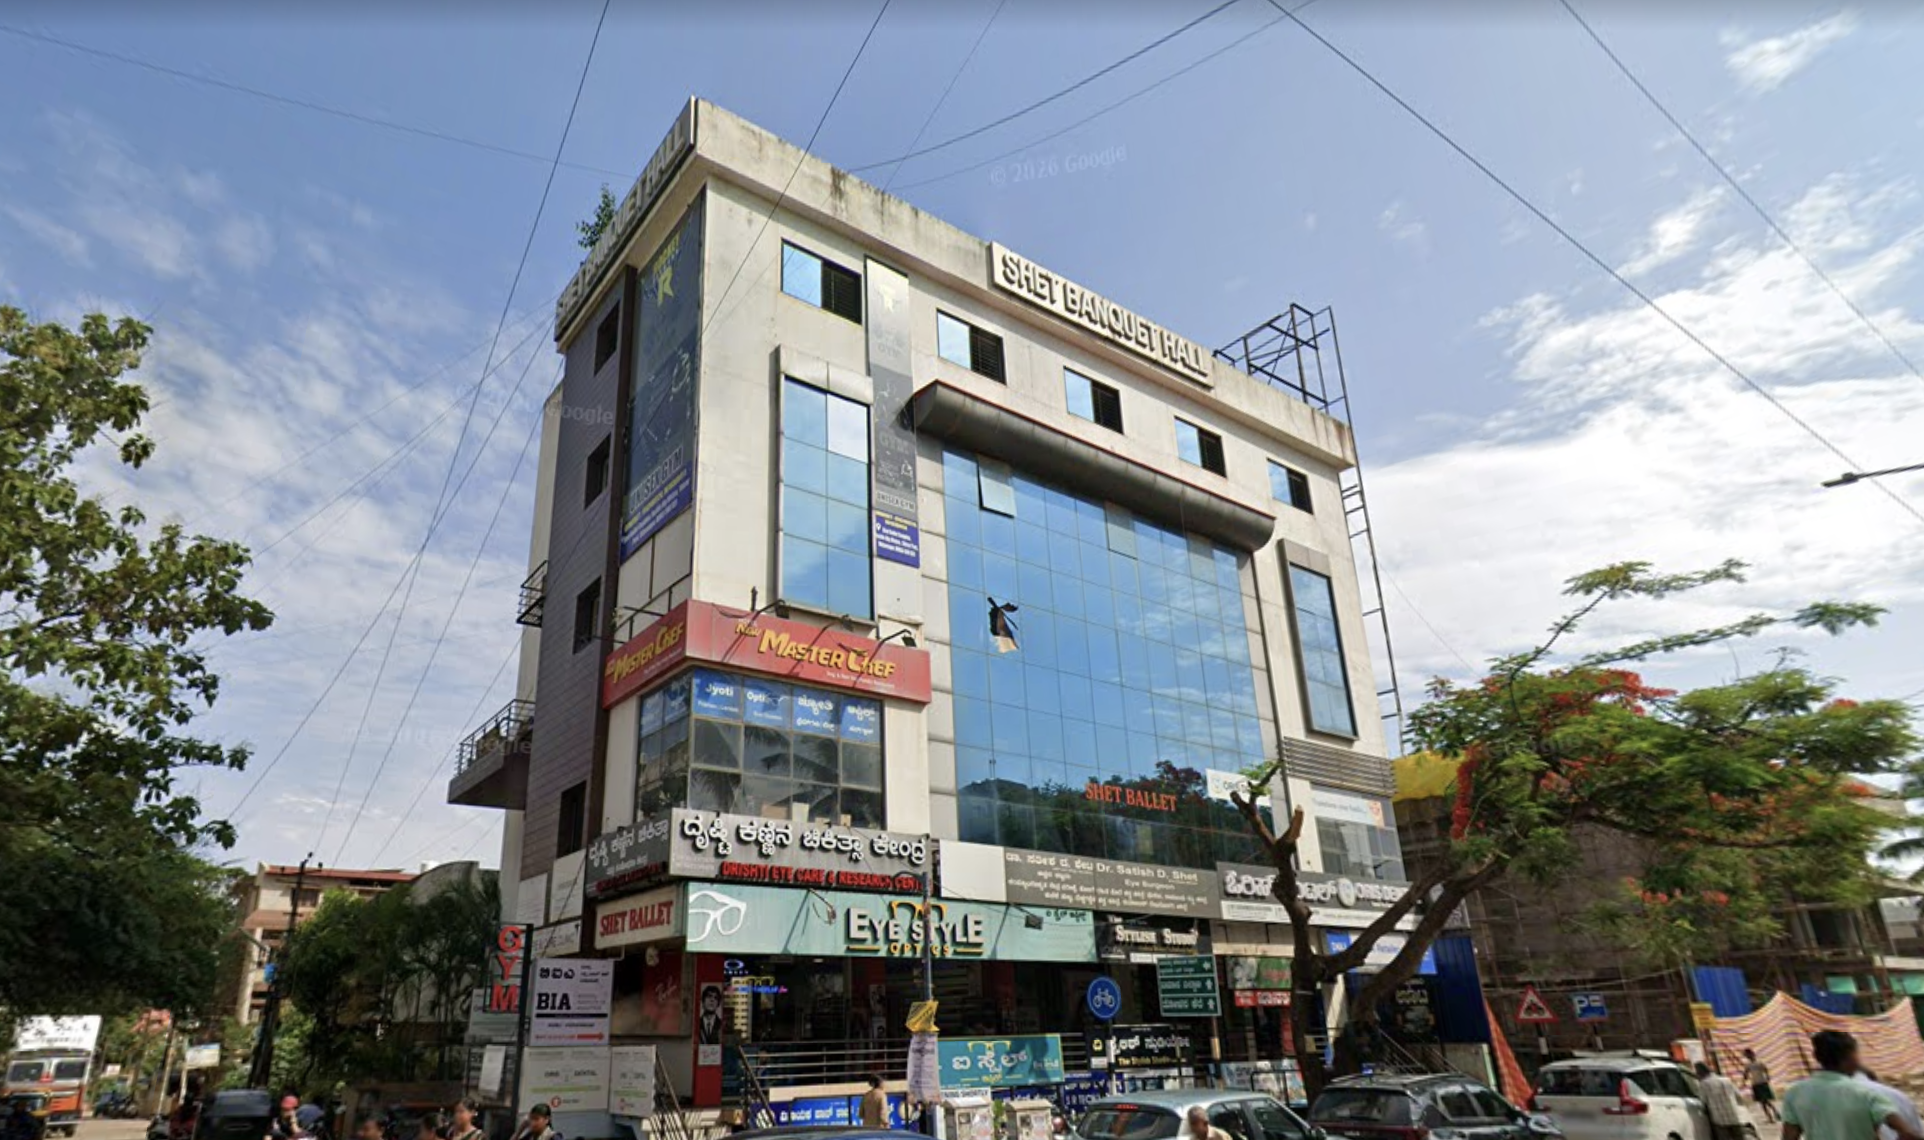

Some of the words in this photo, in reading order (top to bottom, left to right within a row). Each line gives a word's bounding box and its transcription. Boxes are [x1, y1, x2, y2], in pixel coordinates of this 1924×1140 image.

[1002, 251, 1060, 306] SHET
[1062, 281, 1160, 353] BANQUET
[1161, 327, 1210, 379] HALL
[705, 683, 734, 698] Jyoti
[1085, 782, 1122, 804] SHET
[1125, 787, 1178, 812] BALLET
[684, 816, 732, 855] ದೃಷ್ಟಿ
[739, 821, 793, 855] ಕಣ್ಣಿನ
[803, 829, 864, 860] ಚಿಕಿತ್ಸಾ
[872, 833, 926, 864] ಕೇಂದ್ರ
[721, 861, 769, 879] DRISHTI
[771, 865, 793, 882] EYE
[795, 867, 825, 884] CARE
[826, 870, 836, 885] &
[837, 870, 892, 888] RESEARCH
[1096, 862, 1115, 873] Dr.
[1116, 864, 1155, 878] Satish
[1172, 870, 1198, 882] Shet
[600, 910, 627, 937] SHET
[628, 900, 674, 931] BALLET
[911, 912, 984, 944] STYLE
[890, 942, 950, 957] OPTCS
[489, 925, 523, 1013] GYM
[536, 992, 571, 1010] BIA
